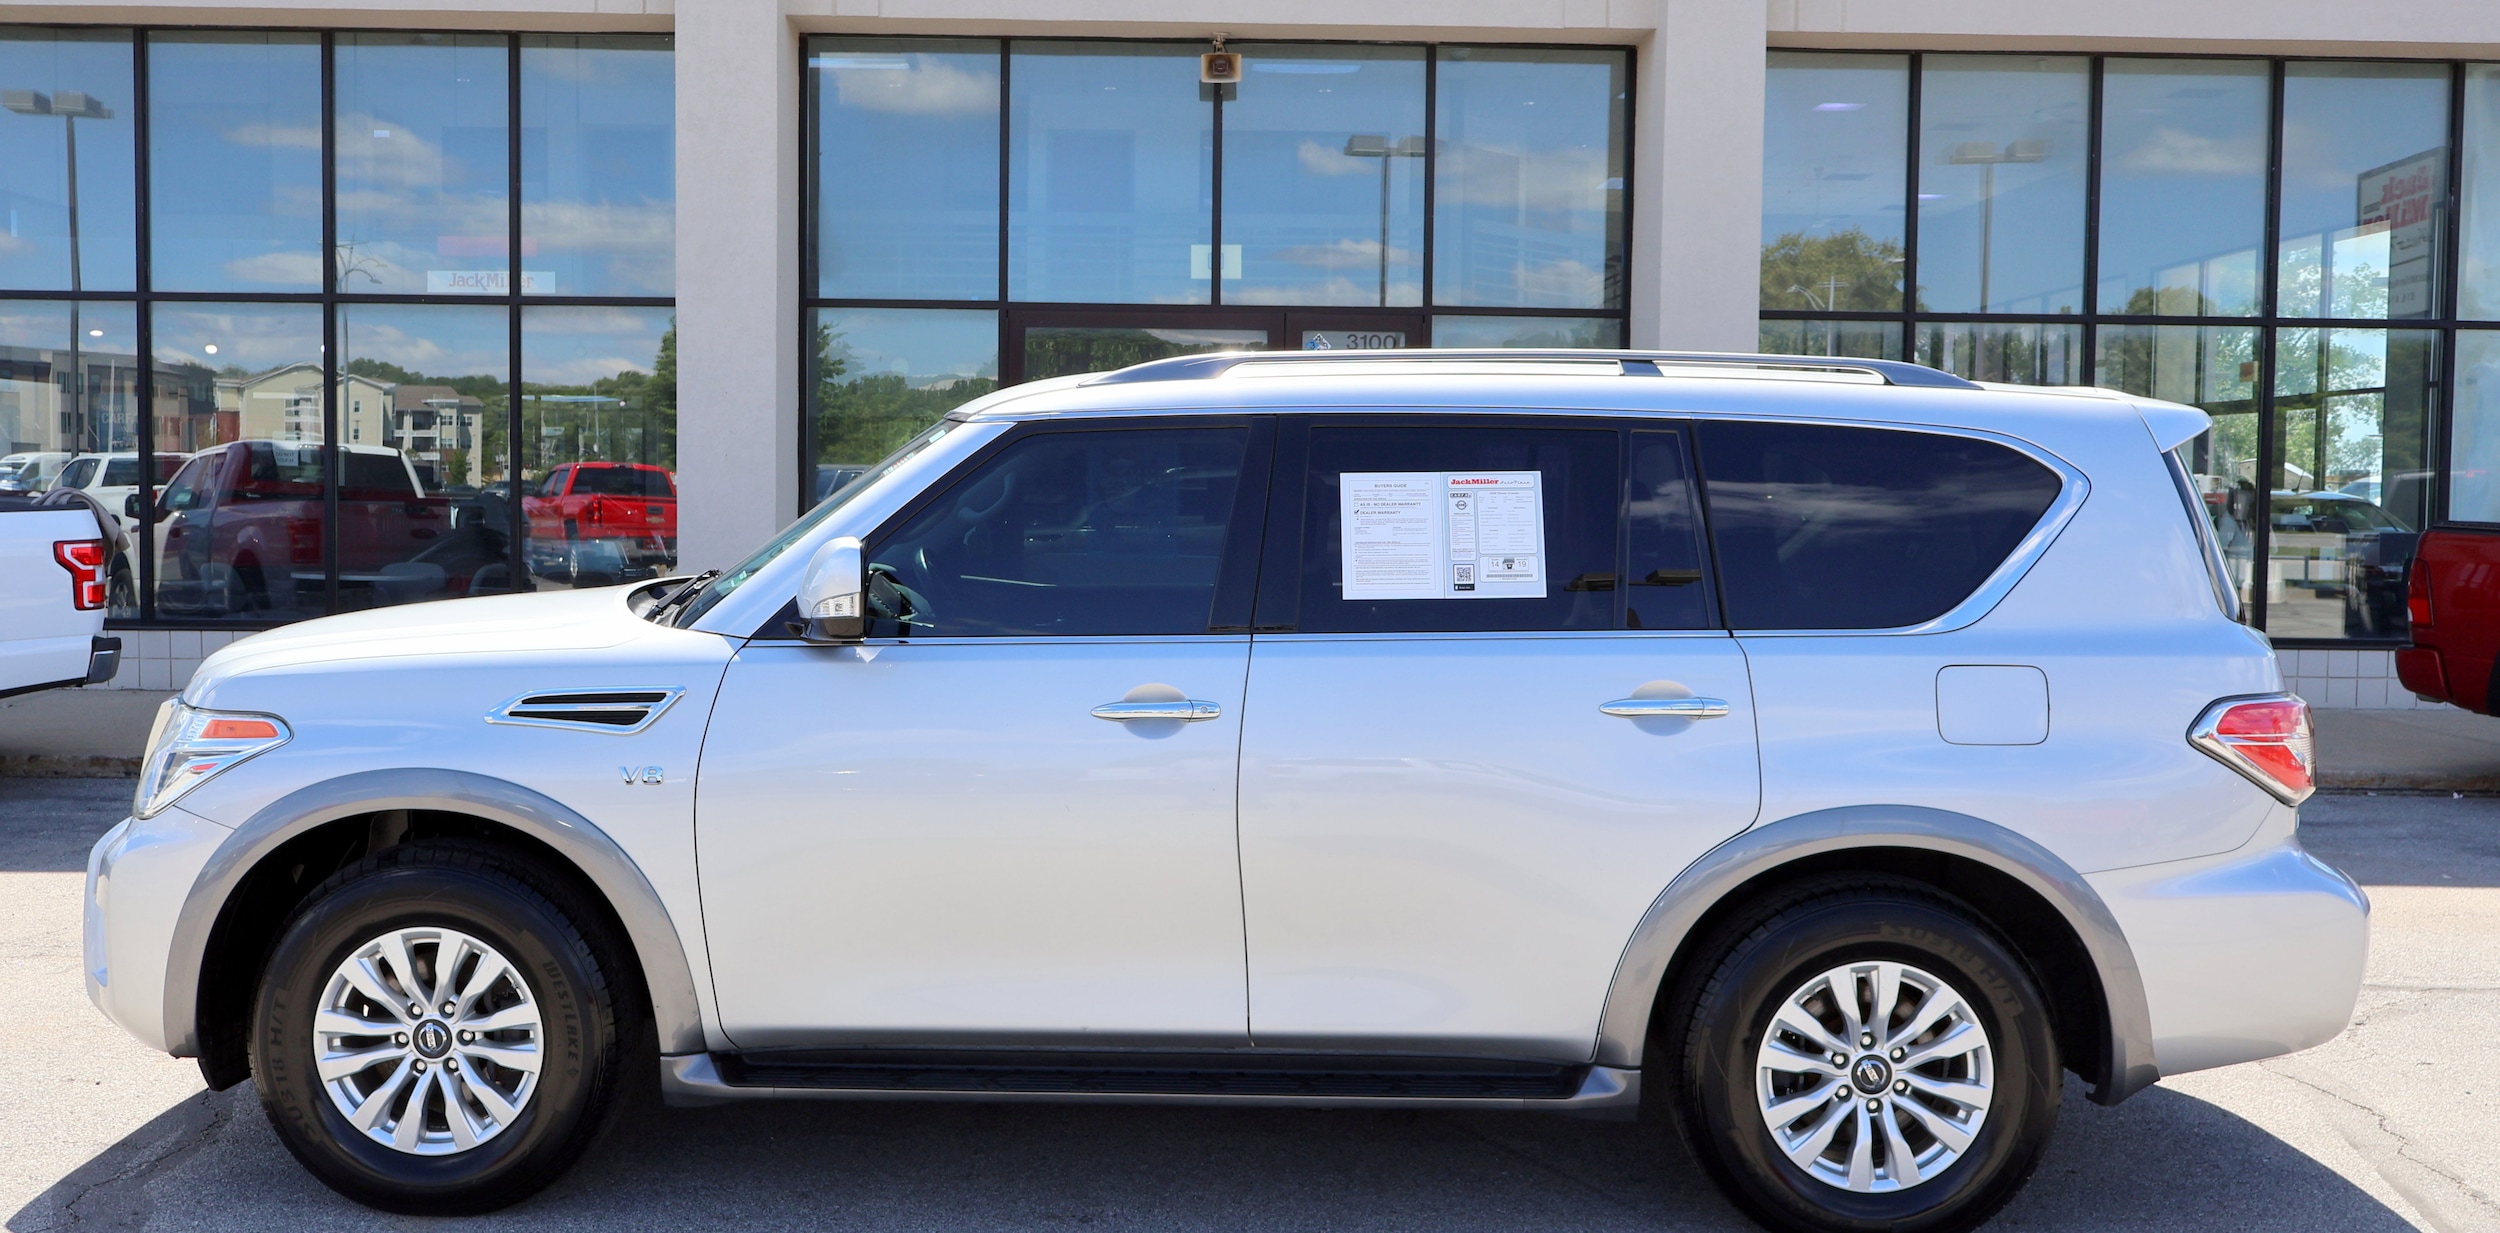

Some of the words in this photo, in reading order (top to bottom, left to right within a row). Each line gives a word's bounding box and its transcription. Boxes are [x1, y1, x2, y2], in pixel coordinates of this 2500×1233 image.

[448, 272, 534, 291] JackMiler
[1346, 333, 1397, 350] 3100
[101, 412, 139, 424] CARFA
[618, 765, 664, 786] V8
[270, 996, 286, 1046] H/T
[543, 961, 579, 1062] WESTLAKE
